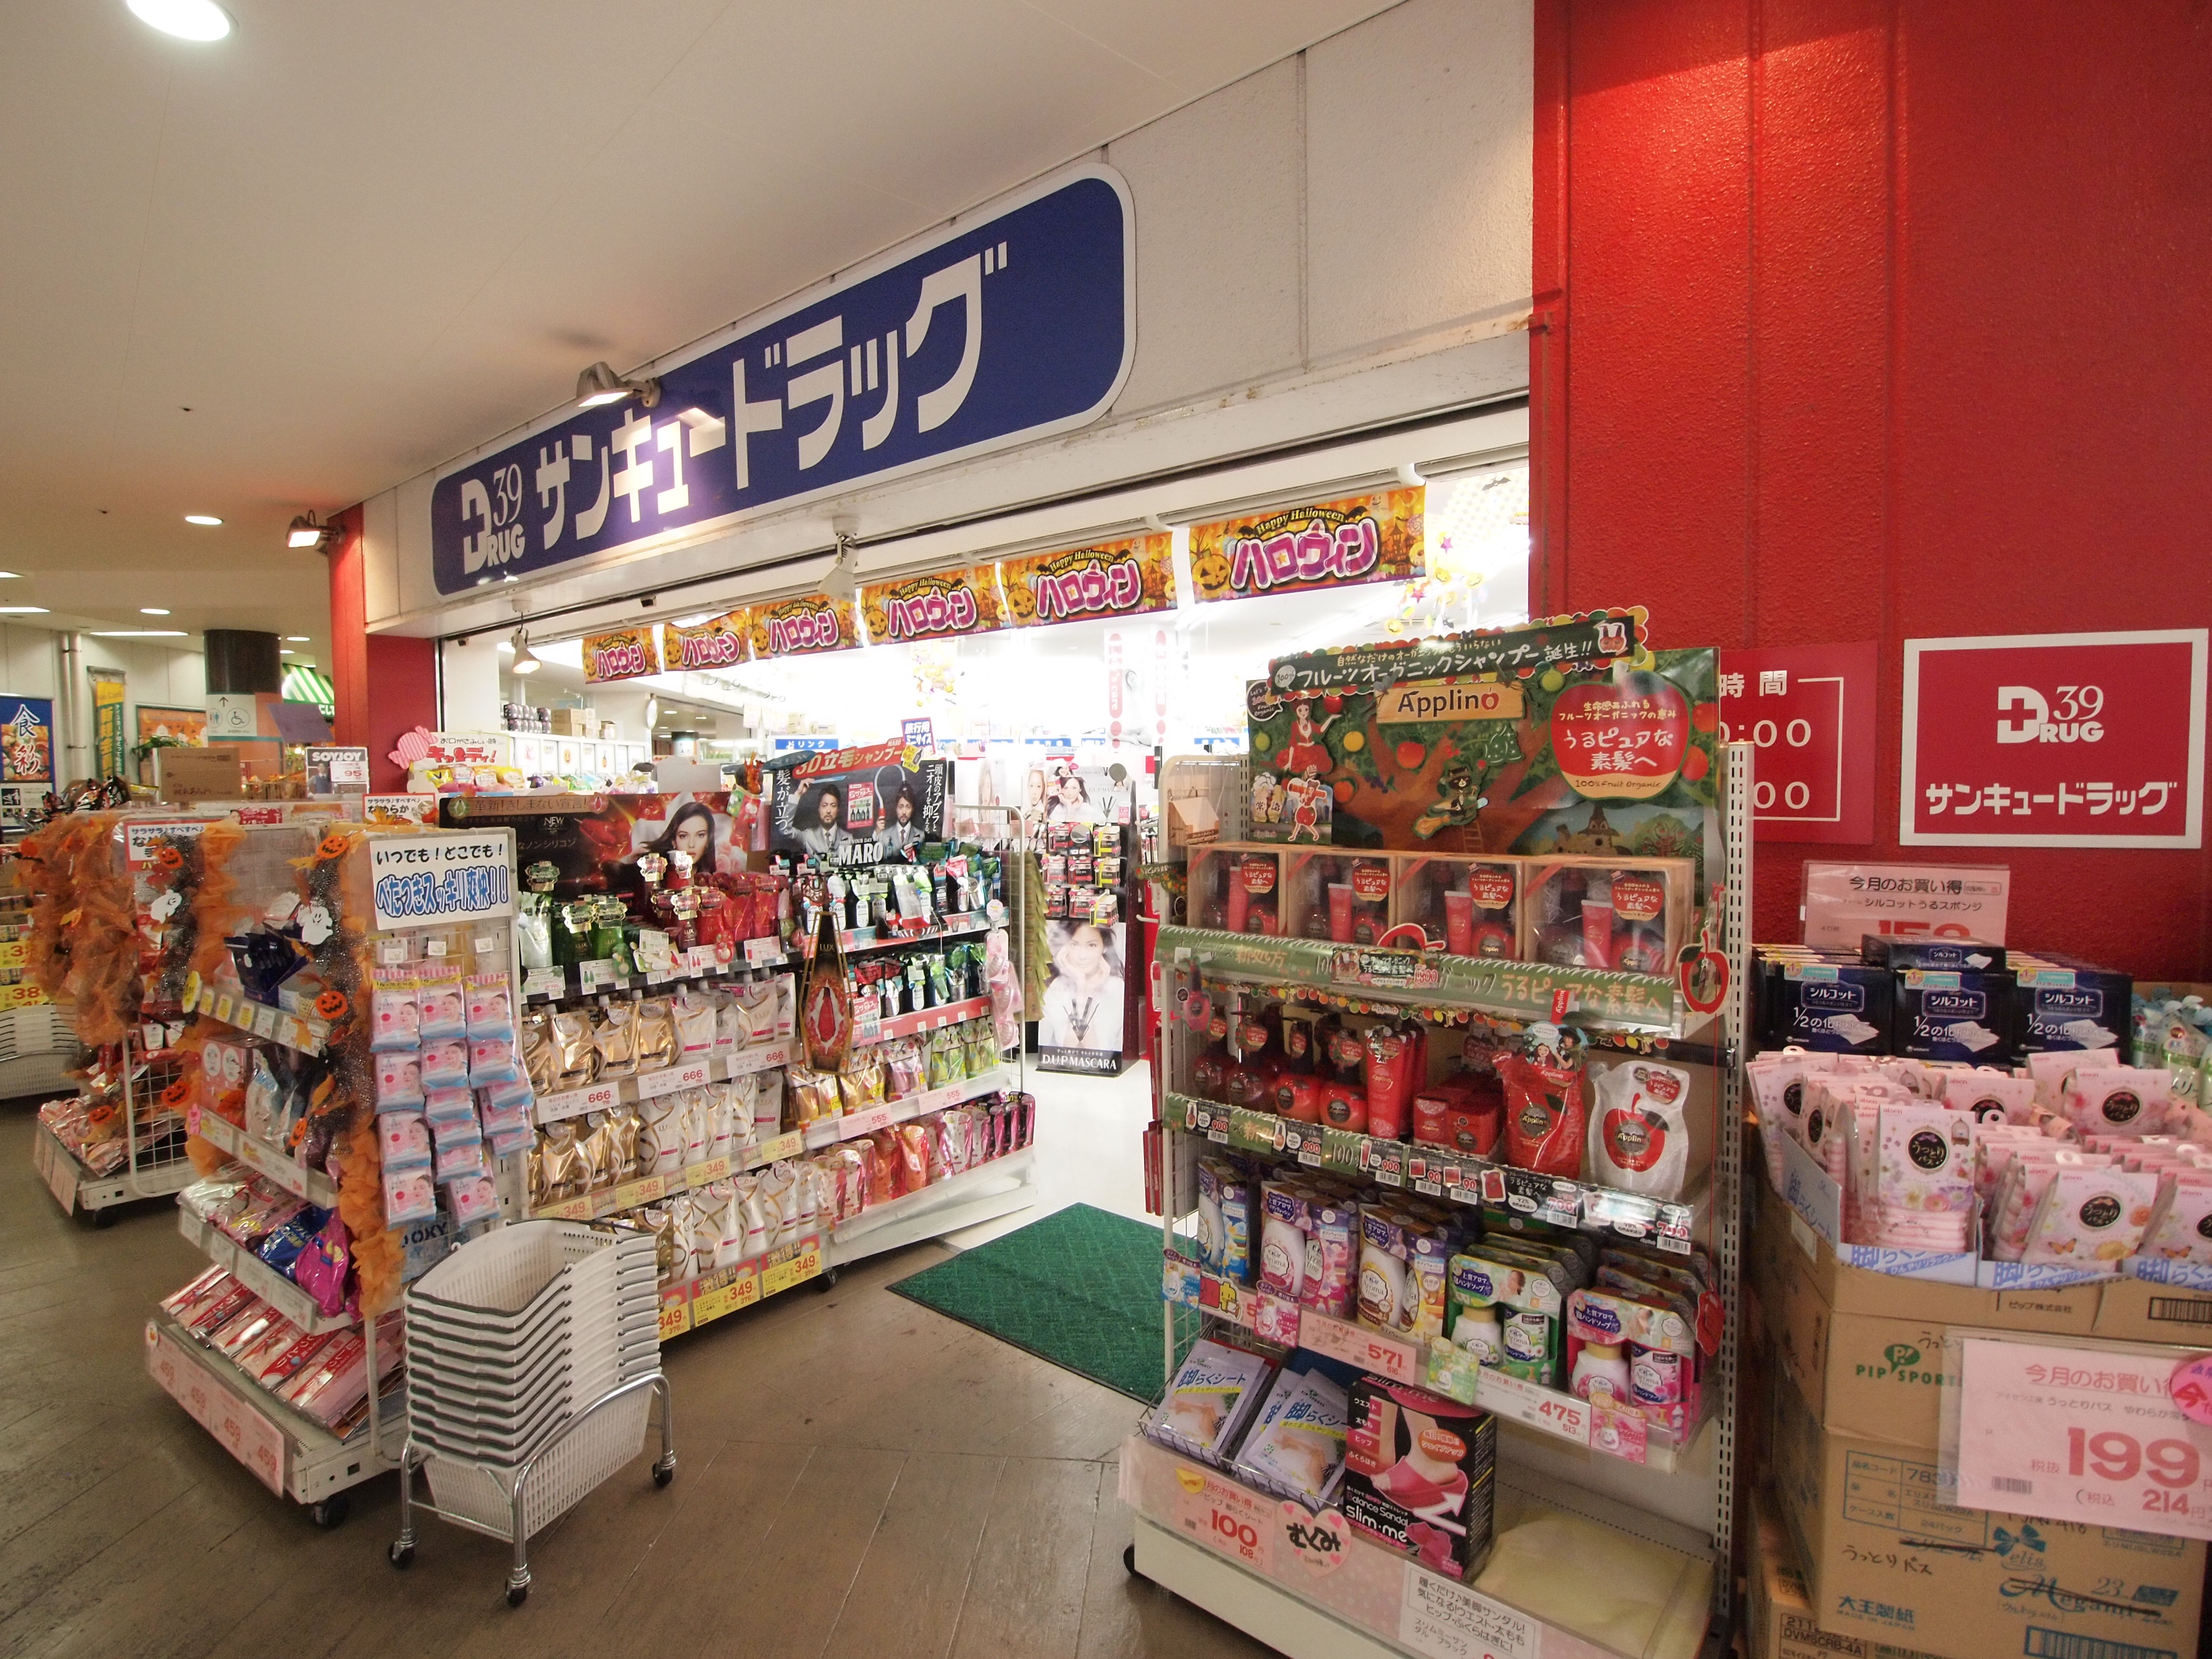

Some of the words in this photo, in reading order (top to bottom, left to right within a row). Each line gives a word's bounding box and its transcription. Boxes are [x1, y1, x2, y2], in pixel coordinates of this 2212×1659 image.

[537, 241, 1007, 549] サンキュードラッグ
[492, 462, 522, 527] 39
[462, 477, 525, 574] DRUG
[1257, 512, 1289, 533] Happy
[1291, 508, 1344, 522] Halloween
[1049, 554, 1073, 572] Happy
[1075, 550, 1114, 563] Halloween
[1230, 518, 1379, 590] ハロウィン
[900, 582, 917, 596] Happy
[918, 578, 951, 591] Halloween
[1036, 560, 1142, 619] ハロウィン
[889, 586, 978, 637] ハロウィン
[769, 608, 838, 653] ハロウィン
[682, 631, 740, 666] ハロウィン
[1277, 670, 1295, 684] 100%
[1296, 644, 1539, 687] フルーツオーガニックシャンプー
[1544, 640, 1592, 662] 誕生!!
[1720, 669, 1788, 698] 時間
[1397, 687, 1500, 718] Applino
[1583, 699, 1650, 712] 生命感あふれる
[2052, 685, 2104, 721] 39
[1559, 708, 1677, 721] フルーツオーガニックの恵み
[1996, 686, 2105, 744] DRUG
[905, 720, 930, 734] 旅行用
[10, 703, 41, 776] 食彩
[786, 740, 825, 750] ドリンク
[1564, 726, 1674, 749] うるピュアな
[312, 752, 362, 762] SOYJOY
[795, 746, 903, 776] 3D立毛シャンプー
[1590, 751, 1657, 771] 素髪へ
[1601, 780, 1623, 788] Fruit
[1626, 780, 1661, 789] Organic
[474, 797, 588, 814] 革新!きしまない宣言!
[775, 769, 791, 835] 髪が立つ。
[932, 763, 944, 832] 頭皮のアブラと
[1926, 781, 2178, 816] サンキュードラッグ
[1255, 802, 1266, 812] 常
[377, 843, 503, 865] いつでも!どこでも!
[838, 842, 884, 866] MARO
[376, 865, 509, 918] べたつきスッキリ爽快!!
[1849, 876, 1962, 895] 今月のお買い得
[1865, 896, 1983, 912] シルコットうるスポンジ
[820, 943, 836, 952] LUX
[1933, 951, 1958, 960] シルコット
[12, 987, 41, 1000] 38
[1502, 973, 1663, 1016] うるピアな素髪へ
[1810, 987, 1857, 1000] シルコット
[1930, 995, 1978, 1008] シルコット
[2045, 992, 2095, 1006] シルコット
[1373, 1005, 1398, 1013] Applino
[766, 1051, 784, 1062] 666
[1042, 1053, 1069, 1066] D.U.P
[1069, 1056, 1117, 1071] MASCARA
[682, 1069, 703, 1082] 666
[1541, 1069, 1564, 1079] Applino
[588, 1090, 612, 1104] 666
[946, 1090, 960, 1100] 555
[871, 1113, 887, 1125] 555
[1211, 1120, 1228, 1132] 900
[779, 1137, 797, 1150] 349
[1302, 1141, 1321, 1154] 900
[706, 1160, 725, 1175] 349
[1381, 1159, 1400, 1172] 900
[1427, 1170, 1441, 1183] 90
[1463, 1178, 1477, 1192] 90
[639, 1179, 658, 1195] 349
[564, 1200, 586, 1216] 349
[1547, 1197, 1576, 1214] 700
[795, 1255, 816, 1273] 349
[804, 1268, 814, 1278] 376
[730, 1280, 753, 1301] 349
[741, 1295, 752, 1305] 376
[2008, 1299, 2073, 1313] ピップ株式会社
[657, 1309, 682, 1331] 349
[669, 1324, 681, 1335] 376
[1368, 1344, 1403, 1366] 571
[1178, 1367, 1246, 1388] 脚らくシート
[1386, 1366, 1399, 1376] 616
[1856, 1364, 1887, 1379] PIP
[1898, 1370, 1962, 1387] SPORT
[1354, 1398, 1377, 1410] ウエスト
[2047, 1397, 2112, 1412] うっとりバス
[1285, 1400, 1348, 1427] 脚らくシー
[1539, 1401, 1582, 1426] 475
[1355, 1417, 1373, 1429] 太もも
[1562, 1423, 1577, 1435] 513
[1355, 1435, 1372, 1447] ヒップ
[2031, 1460, 2059, 1474] 税抜
[2067, 1427, 2200, 1489] 199
[1346, 1490, 1379, 1514] Balance
[1379, 1508, 1409, 1527] Sandal
[2142, 1488, 2190, 1515] 214
[1211, 1509, 1258, 1548] 100
[1286, 1522, 1341, 1553] むくみ
[1239, 1544, 1254, 1559] 108
[1842, 1544, 1933, 1576] うっとりバス
[2010, 1551, 2045, 1567] elis
[1838, 1595, 1915, 1624] 大王製紙
